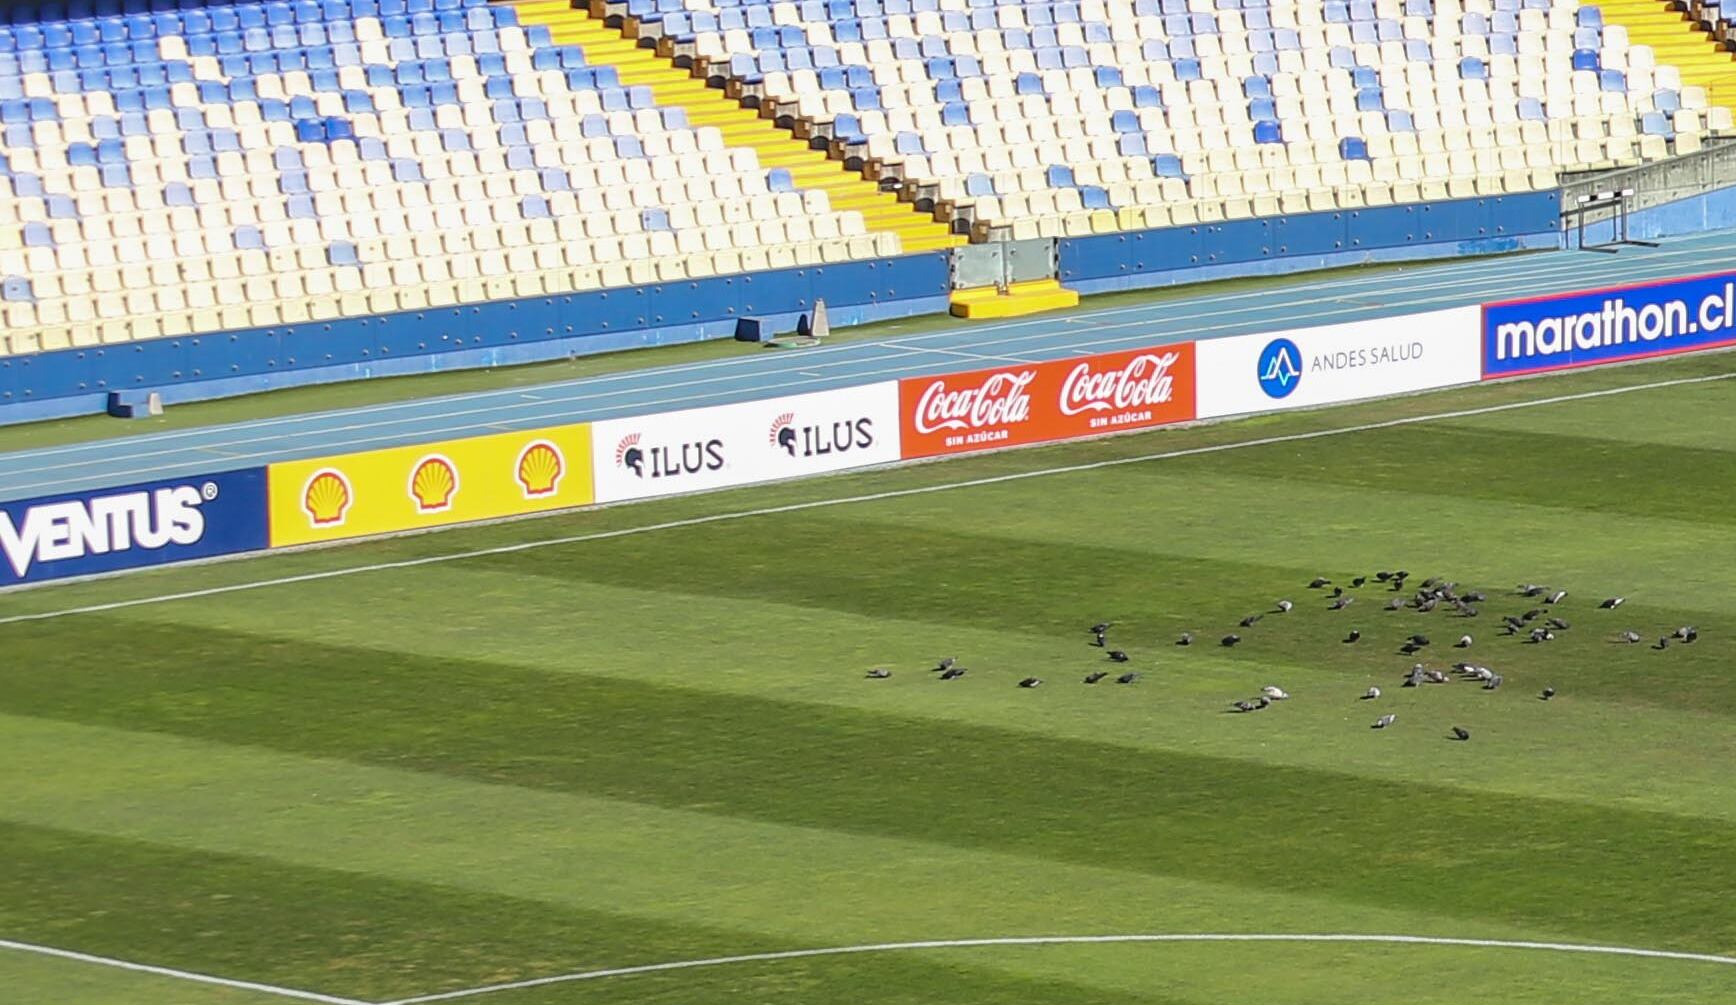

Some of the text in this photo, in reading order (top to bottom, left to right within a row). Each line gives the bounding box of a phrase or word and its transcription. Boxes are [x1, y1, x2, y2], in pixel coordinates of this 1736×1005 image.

[1496, 282, 1735, 361] marathon.cl
[1311, 341, 1424, 373] ANDES SALUD
[802, 417, 874, 457] ILUS
[1089, 411, 1153, 428] SIN AZÚCAR
[945, 430, 1009, 447] SIN AZÚCAR
[650, 438, 724, 478] ILUS
